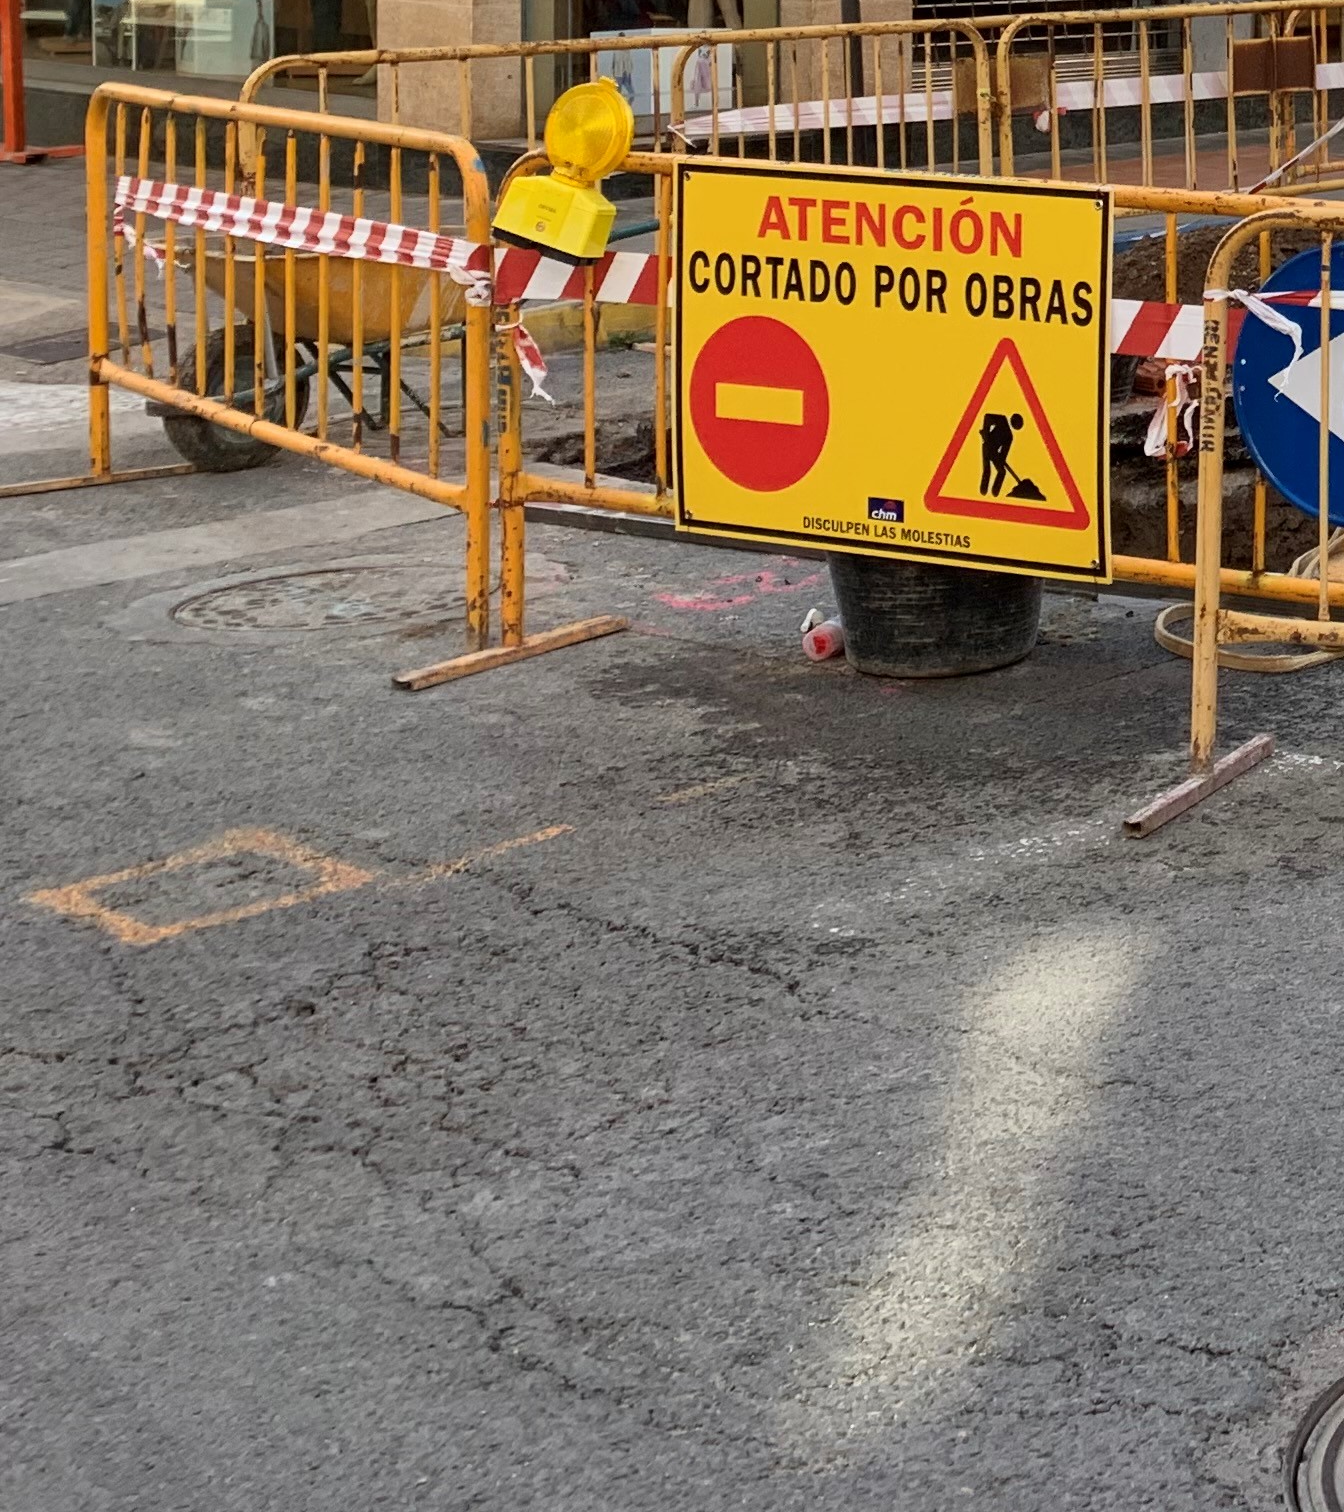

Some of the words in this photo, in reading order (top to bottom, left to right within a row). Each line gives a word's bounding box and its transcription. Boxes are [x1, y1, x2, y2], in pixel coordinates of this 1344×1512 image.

[757, 195, 1023, 258] ATENCIÓN
[689, 251, 857, 306] CORTADO
[874, 264, 948, 314] POR
[965, 272, 1093, 327] OBRAS
[803, 516, 870, 536] DISCULPEN
[874, 524, 896, 539] LAS
[901, 528, 971, 548] MOLESTIAS
[871, 508, 897, 521] chm
